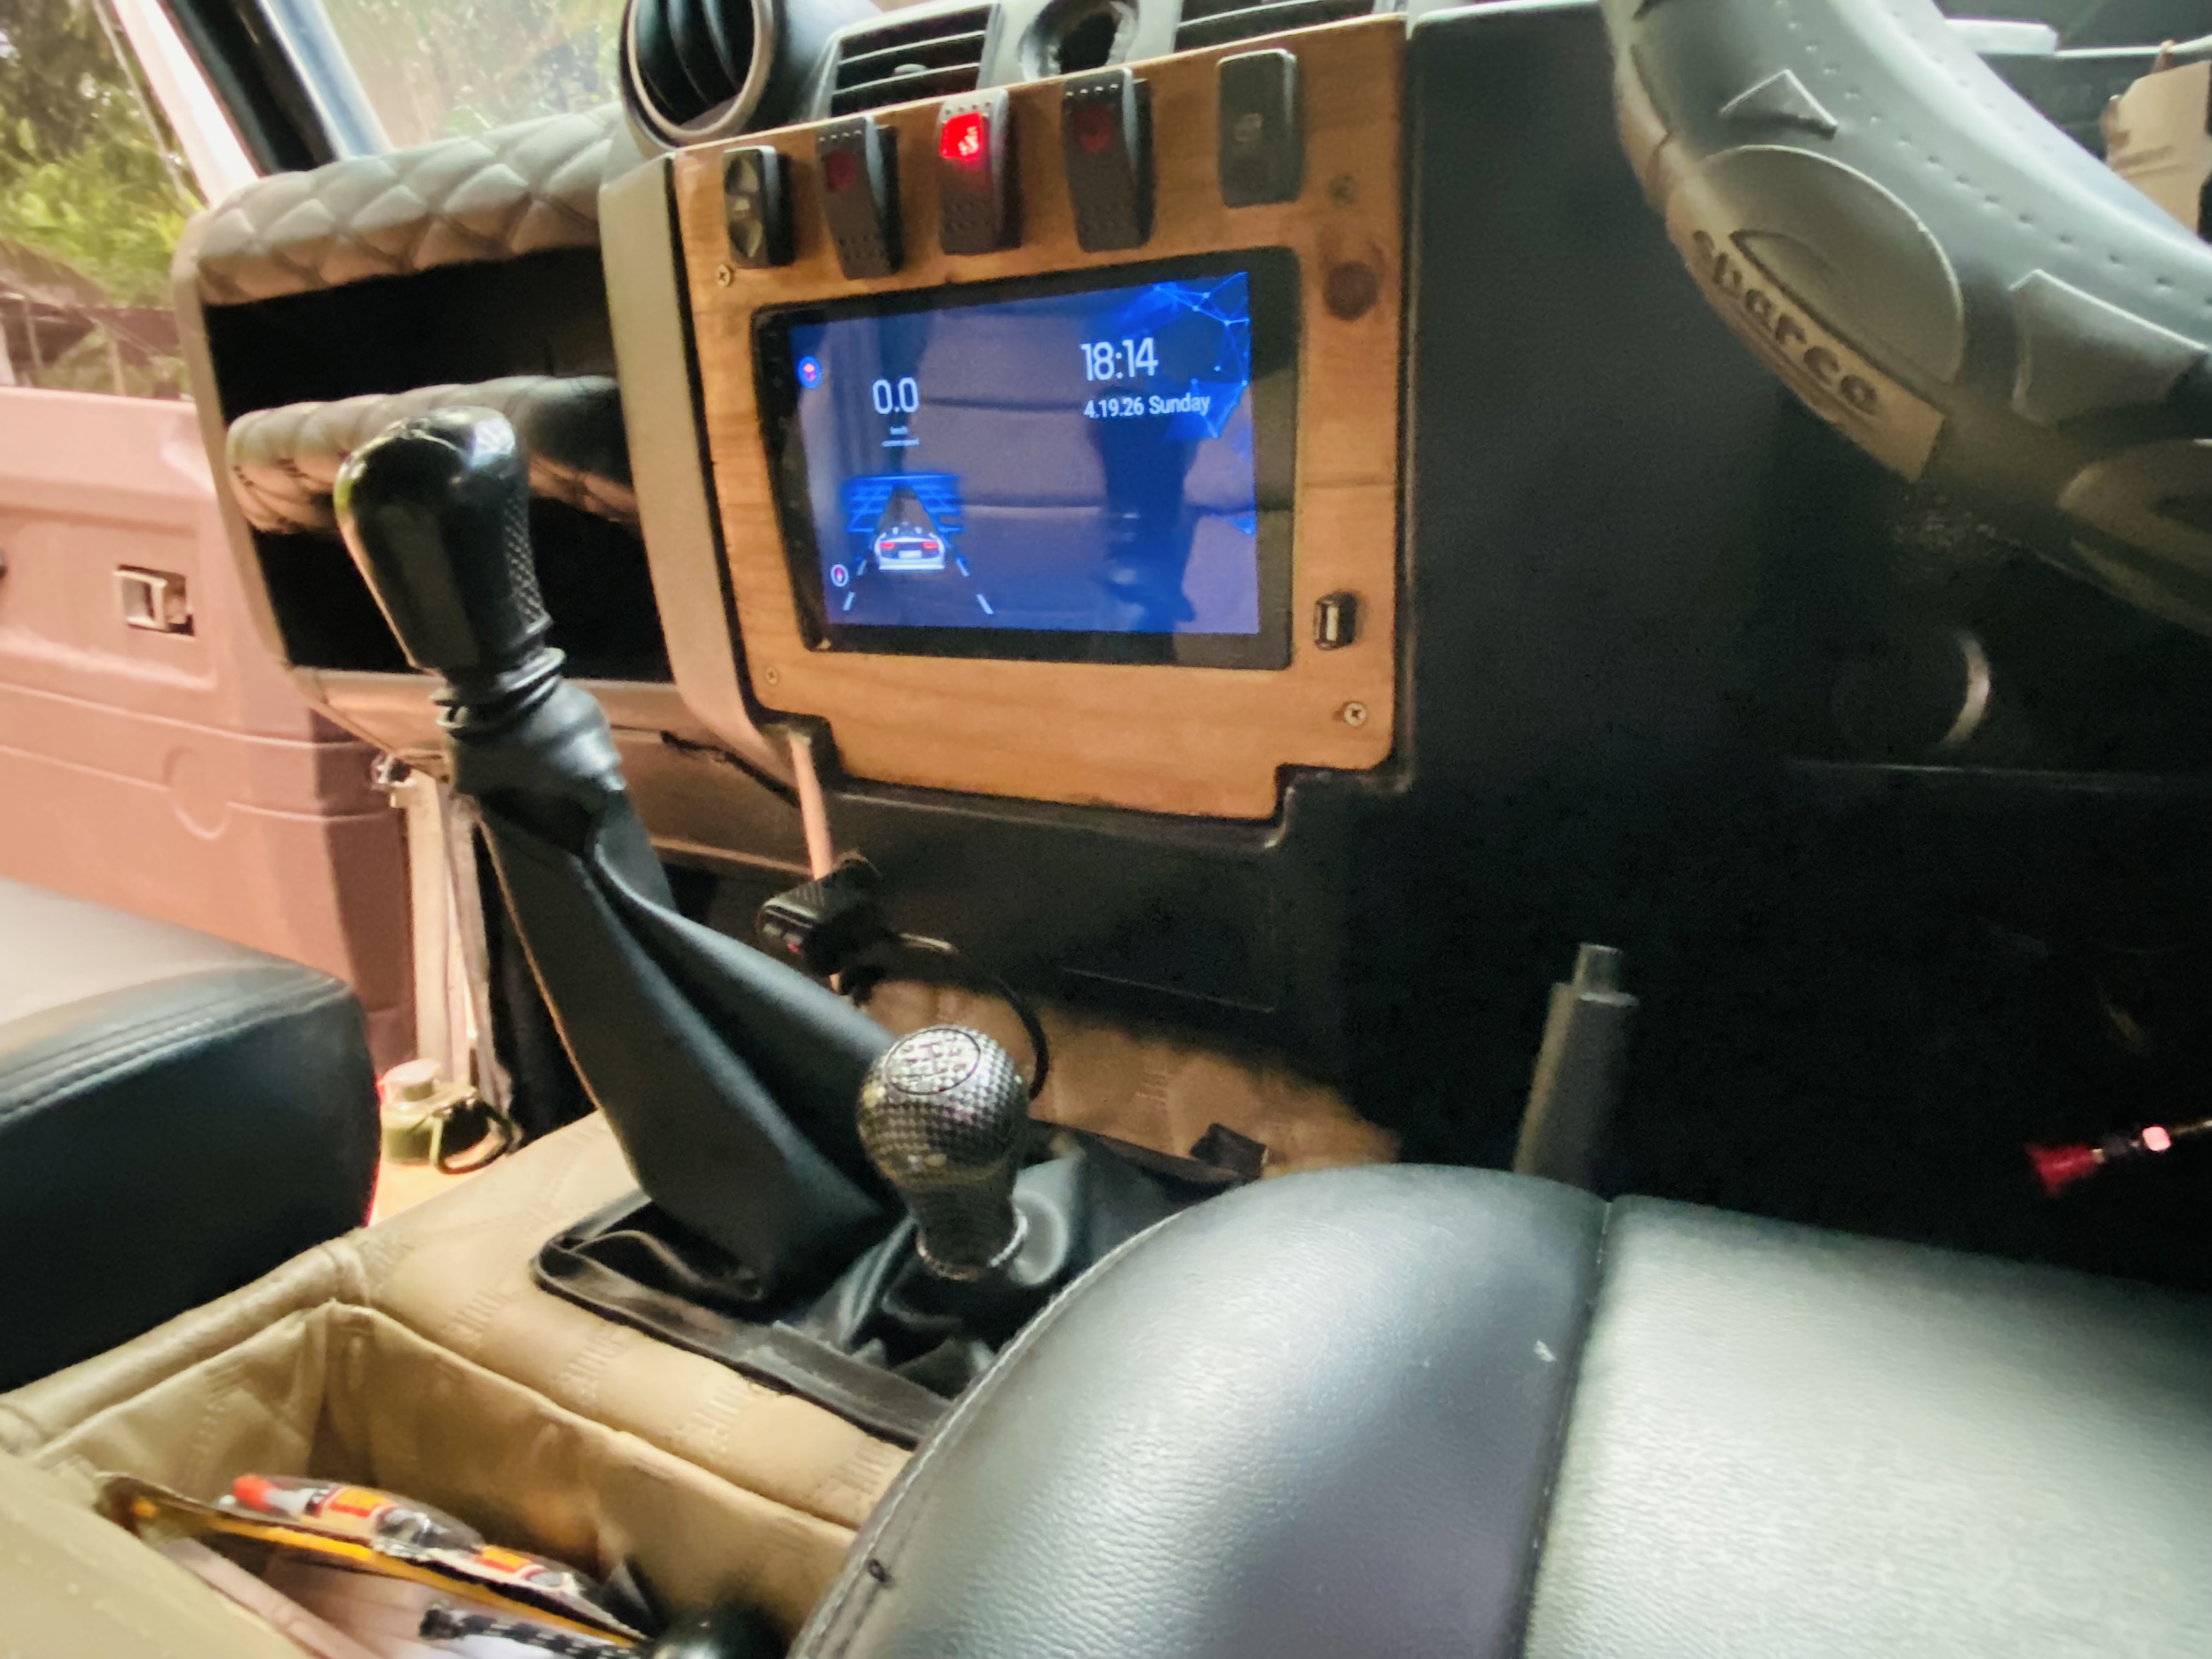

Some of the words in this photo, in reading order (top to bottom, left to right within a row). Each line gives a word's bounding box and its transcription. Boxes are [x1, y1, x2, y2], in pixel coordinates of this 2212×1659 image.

[1080, 336, 1159, 382] 18:14
[872, 376, 919, 415] 0.0
[1083, 396, 1144, 419] 4.19.26
[1149, 392, 1211, 417] Sunday
